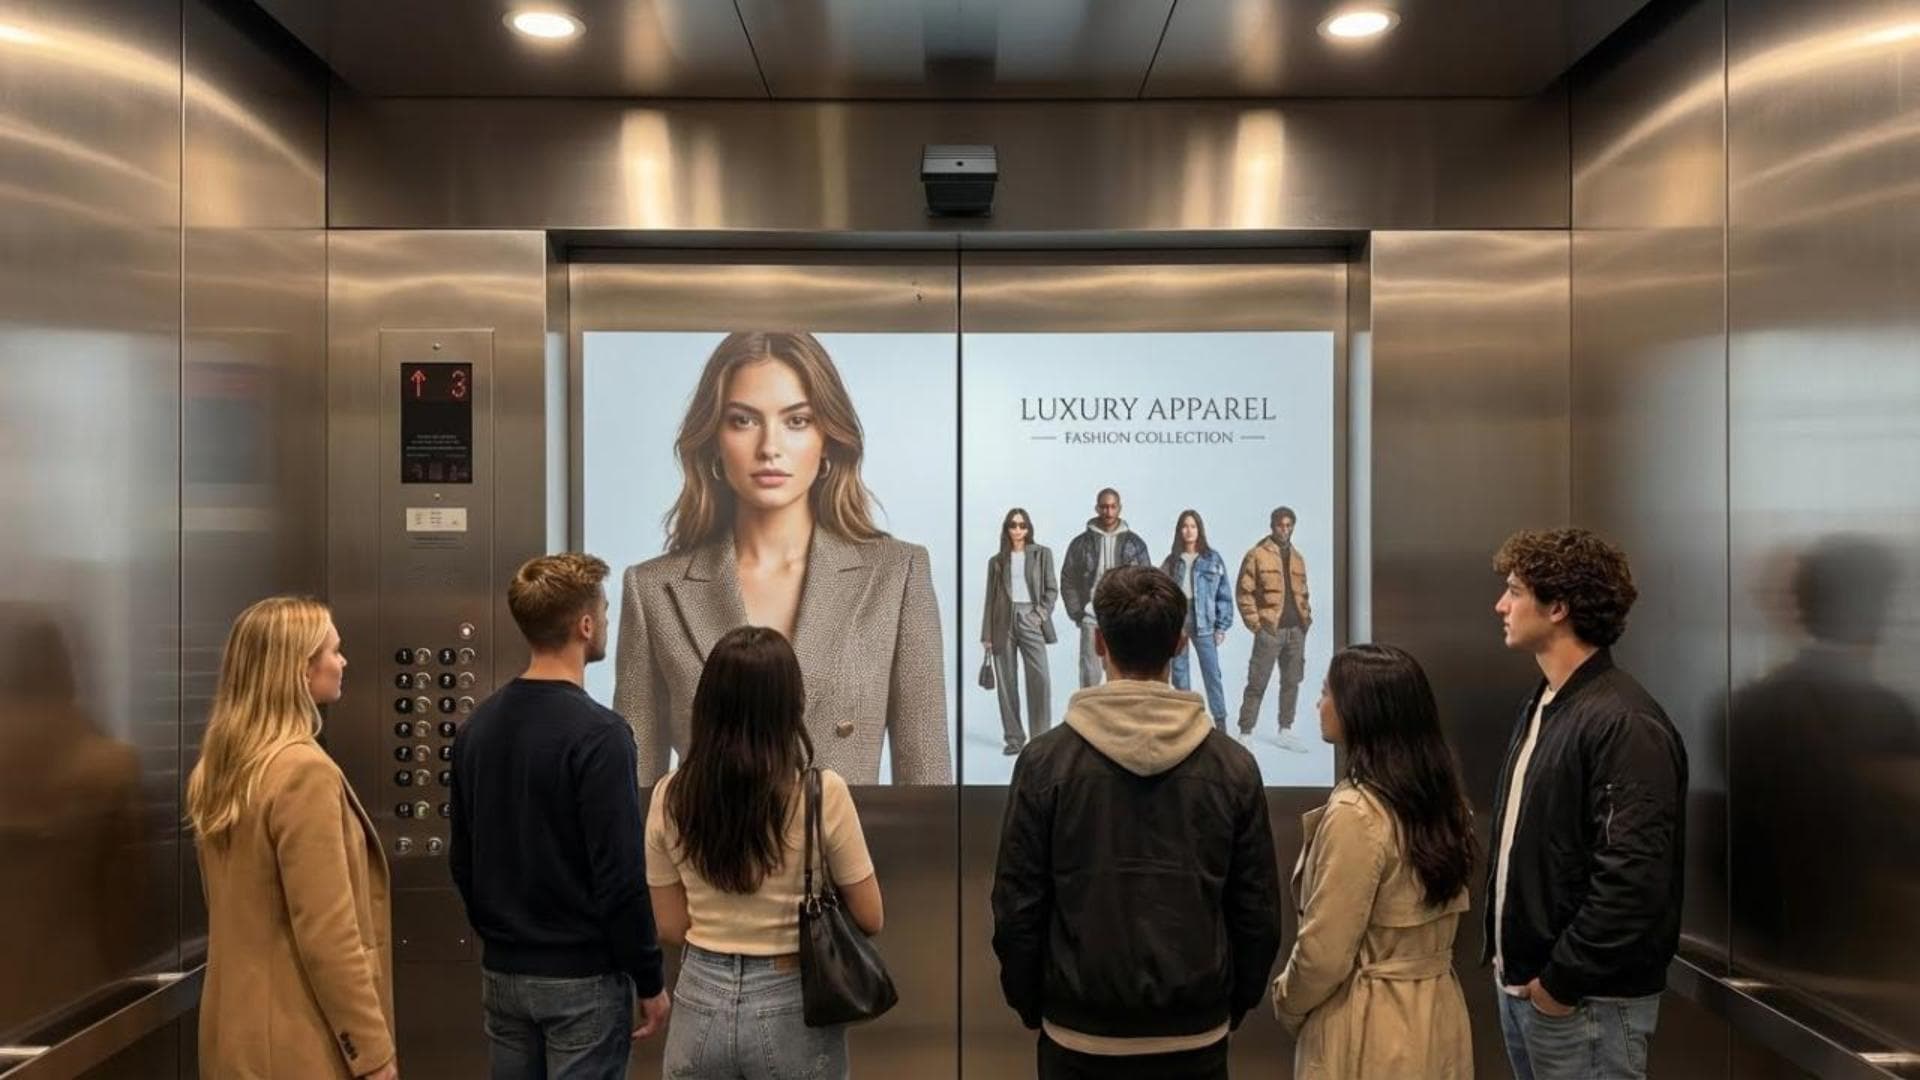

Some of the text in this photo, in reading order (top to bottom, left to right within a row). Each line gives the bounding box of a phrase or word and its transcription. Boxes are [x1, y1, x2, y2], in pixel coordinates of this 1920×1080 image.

[451, 370, 466, 398] 3
[1021, 396, 1277, 421] LUXURY APPAREL
[1064, 431, 1234, 445] FASHION COLLECTION
